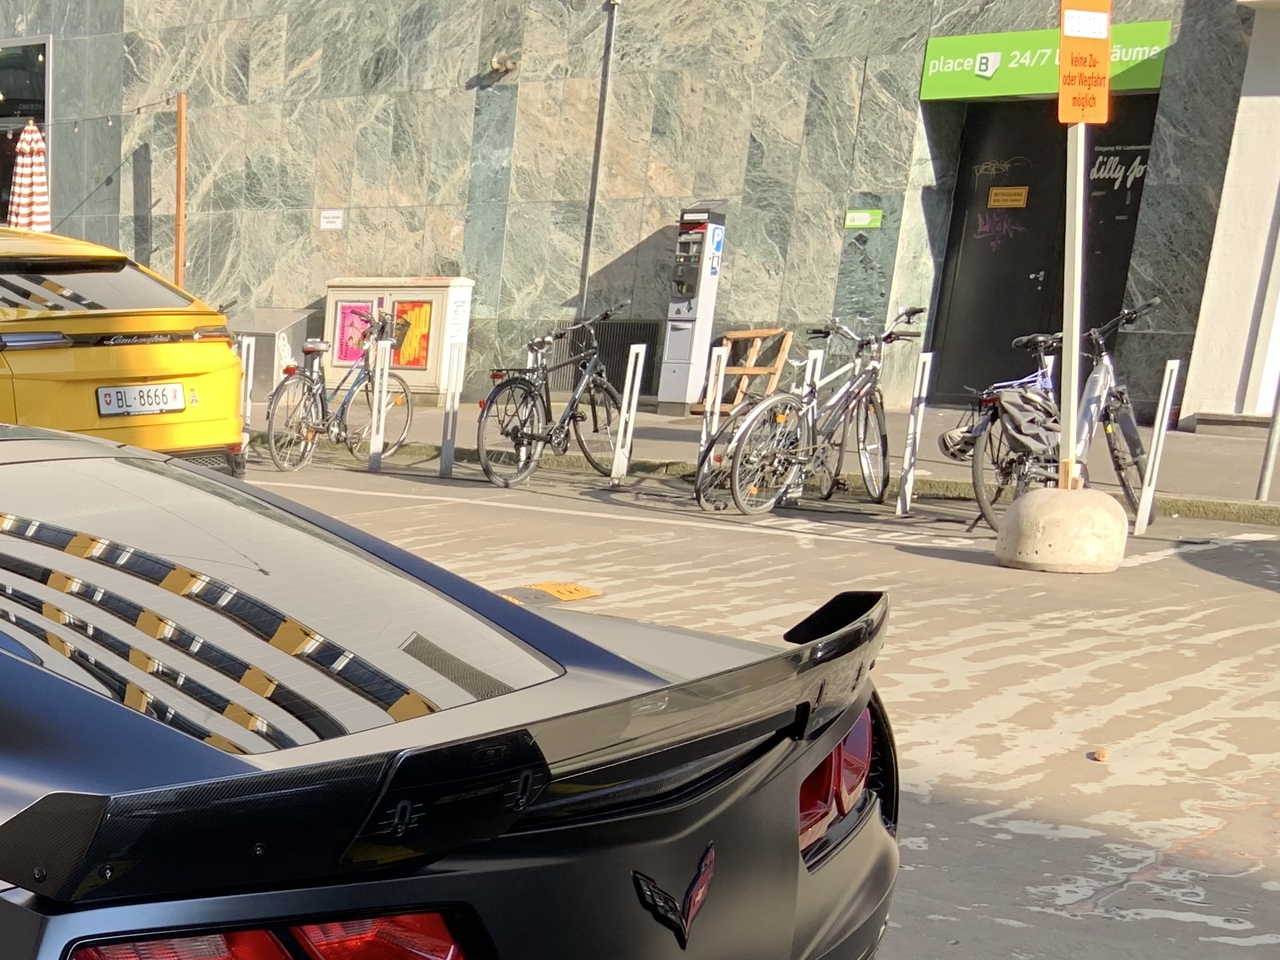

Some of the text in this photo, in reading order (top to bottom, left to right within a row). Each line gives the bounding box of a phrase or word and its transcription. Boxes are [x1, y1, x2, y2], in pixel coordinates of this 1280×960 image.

[1008, 49, 1052, 68] 24/7
[1070, 52, 1088, 68] keine
[1062, 71, 1106, 90] oder Wegfahrt
[1072, 93, 1096, 111] möglich
